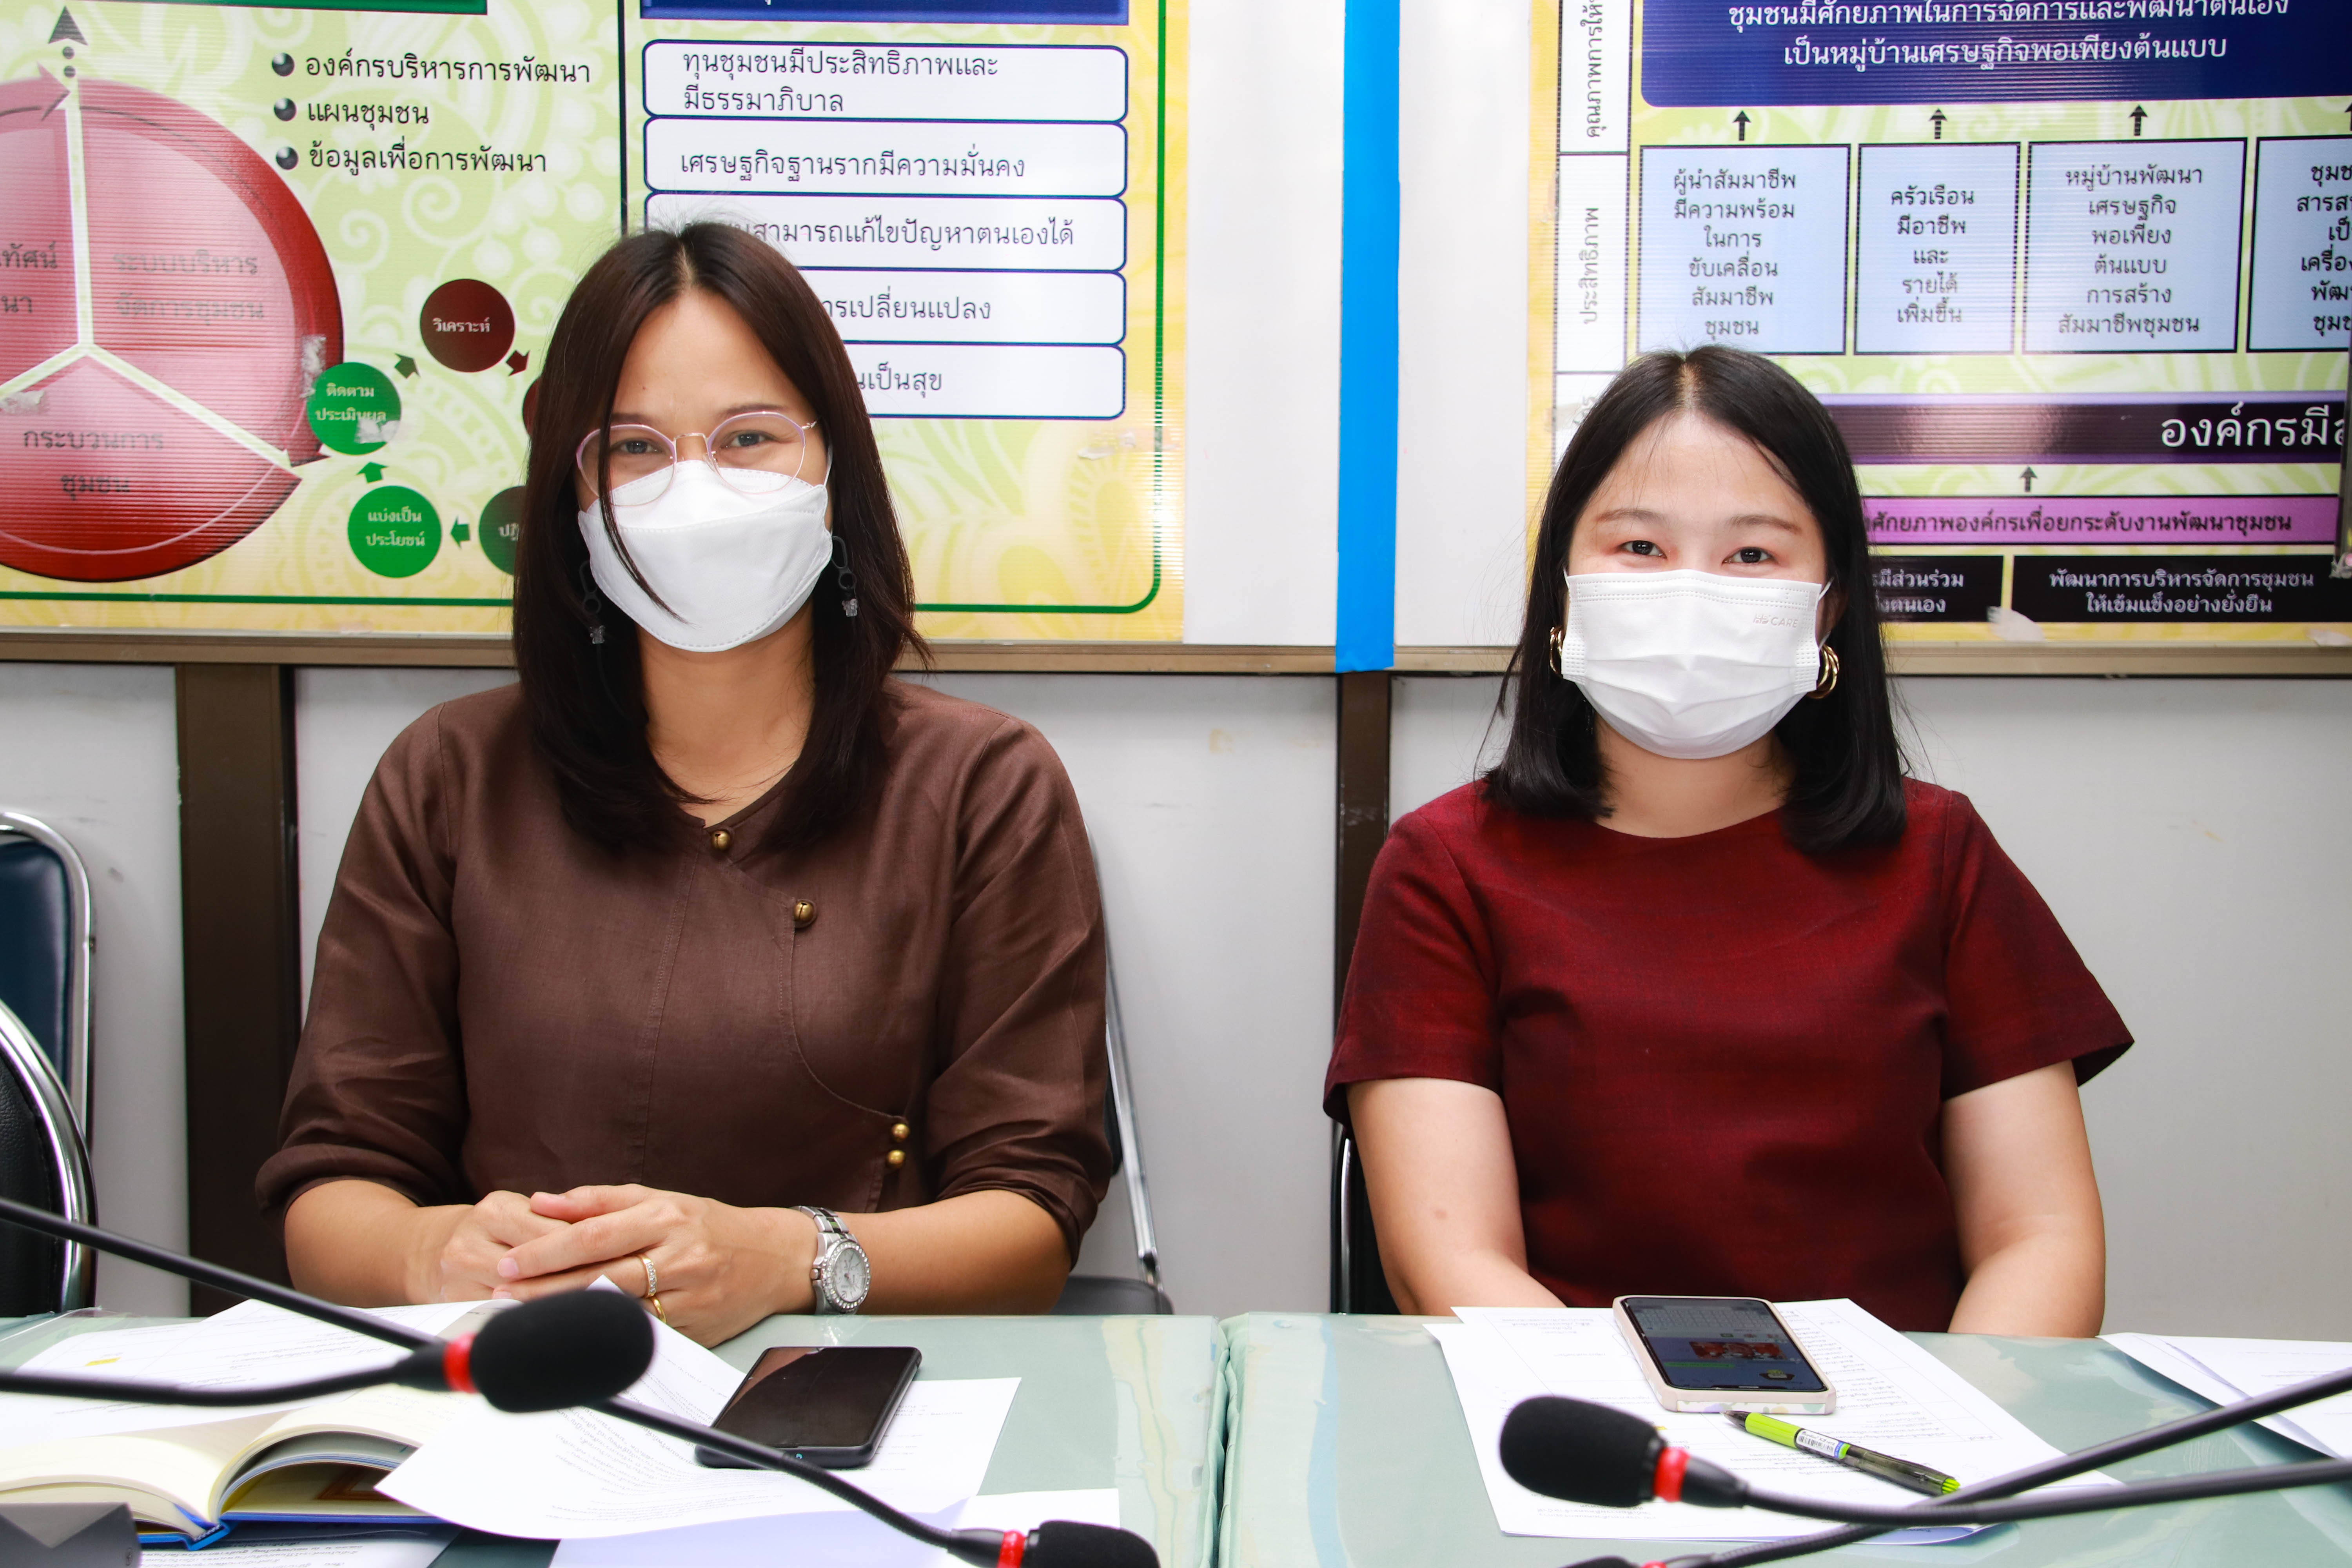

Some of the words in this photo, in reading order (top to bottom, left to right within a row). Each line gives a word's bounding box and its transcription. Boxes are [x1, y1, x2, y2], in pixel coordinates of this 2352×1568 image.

[1784, 32, 2227, 72] เป็นหมู่บ้านเศรษฐกิจพอเพียงต้นแบบ
[306, 47, 591, 82] องค์กรบริหารการพัฒนา
[684, 49, 998, 80] ทุนชุมชนมีประสิทธิภาพและ
[1580, 0, 1607, 137] คุณภาพการให้
[684, 84, 843, 113] มีธรรมาภิบาล
[308, 102, 429, 131] แผนชุมชน
[309, 135, 547, 176] ข้อมูลเพื่อการพัฒนา
[681, 143, 1025, 182] เศรษฐกิจฐานรากมีความมั่นคง
[1674, 168, 1796, 195] ผู้นำสัมมาชีพ
[2065, 164, 2202, 191] หมู่บ้านพัฒนา
[1891, 184, 1975, 206] ครัวเรือน
[2297, 195, 2352, 212] สารส
[1674, 197, 1794, 219] มีความพร้อม
[2089, 194, 2176, 221] เศรษฐกิจ
[1703, 225, 1761, 247] ในการ
[1897, 214, 1966, 235] มีอาชีพ
[2092, 223, 2171, 245] พอเพียง
[114, 249, 258, 274] ระบบบริหาร
[1579, 207, 1600, 324] ประสิทธิภาพ
[1689, 250, 1778, 277] ขับเคลื่อน
[1913, 249, 1948, 264] และ
[2094, 253, 2167, 273] ต้นแบบ
[2301, 244, 2352, 271] เครื่อ
[1902, 270, 1958, 294] รายได้
[2087, 283, 2172, 303] การสร้าง
[2311, 280, 2352, 301] พัฒ
[1692, 285, 1773, 306] สัมมาชีพ
[116, 292, 264, 326] จัดการชุมชน
[1897, 296, 1962, 323] เพิ่มขึ้น
[433, 317, 490, 333] วิเคราะห์
[1705, 320, 1759, 340] ชุมชน
[2058, 312, 2199, 338] สัมมาชีพชุมชน
[325, 382, 374, 397] ติดตาม
[24, 431, 163, 449] กระบวนการ
[61, 475, 131, 501] ชุมชน
[366, 531, 425, 546] ประโยชน์
[2049, 568, 2313, 592] พัฒนาการบริหารจัดการชุมชน
[2086, 589, 2272, 613] ให้เข้มแข็งอย่างยั่งยืน
